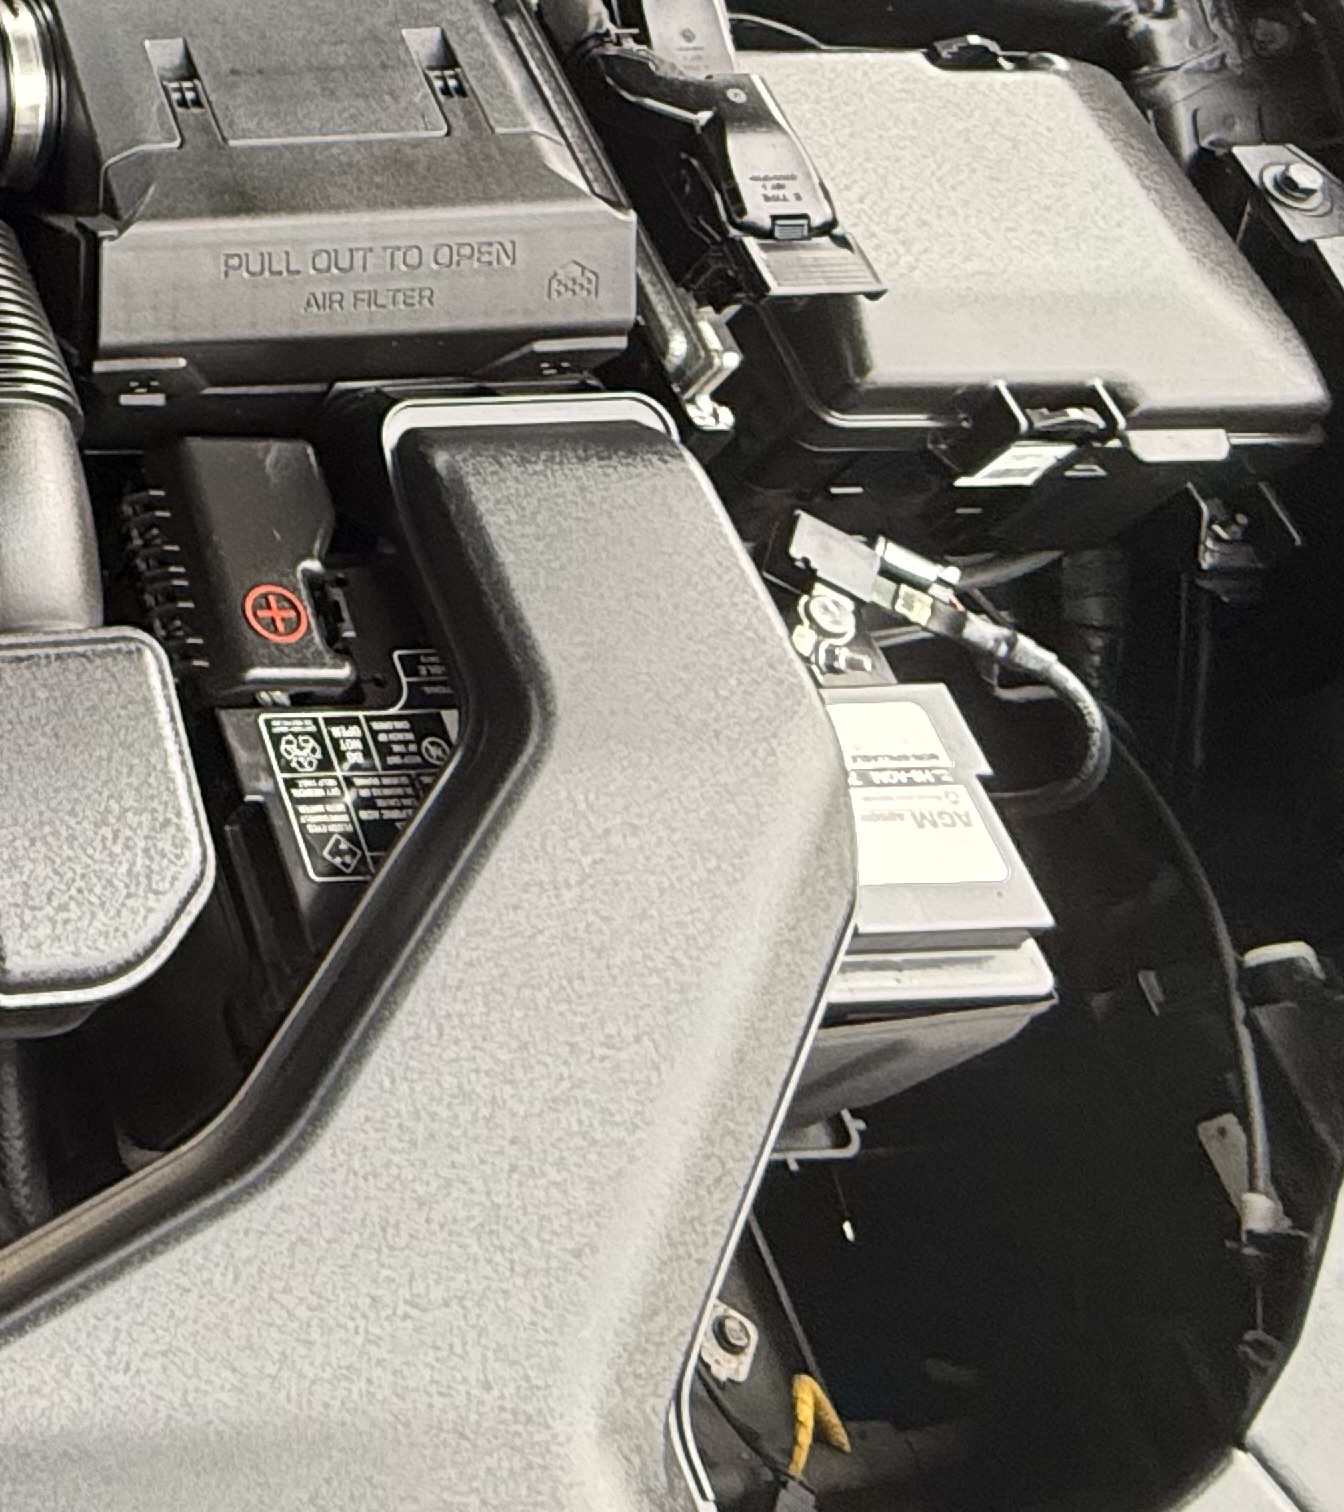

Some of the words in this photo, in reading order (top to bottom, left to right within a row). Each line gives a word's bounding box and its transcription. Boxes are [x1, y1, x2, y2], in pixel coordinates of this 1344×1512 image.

[222, 251, 302, 279] PULL
[311, 246, 374, 275] OUT
[381, 243, 425, 271] TO
[432, 239, 517, 268] OPEN
[302, 289, 345, 313] AIR
[352, 286, 435, 311] FILTER
[908, 809, 974, 830] AGM
